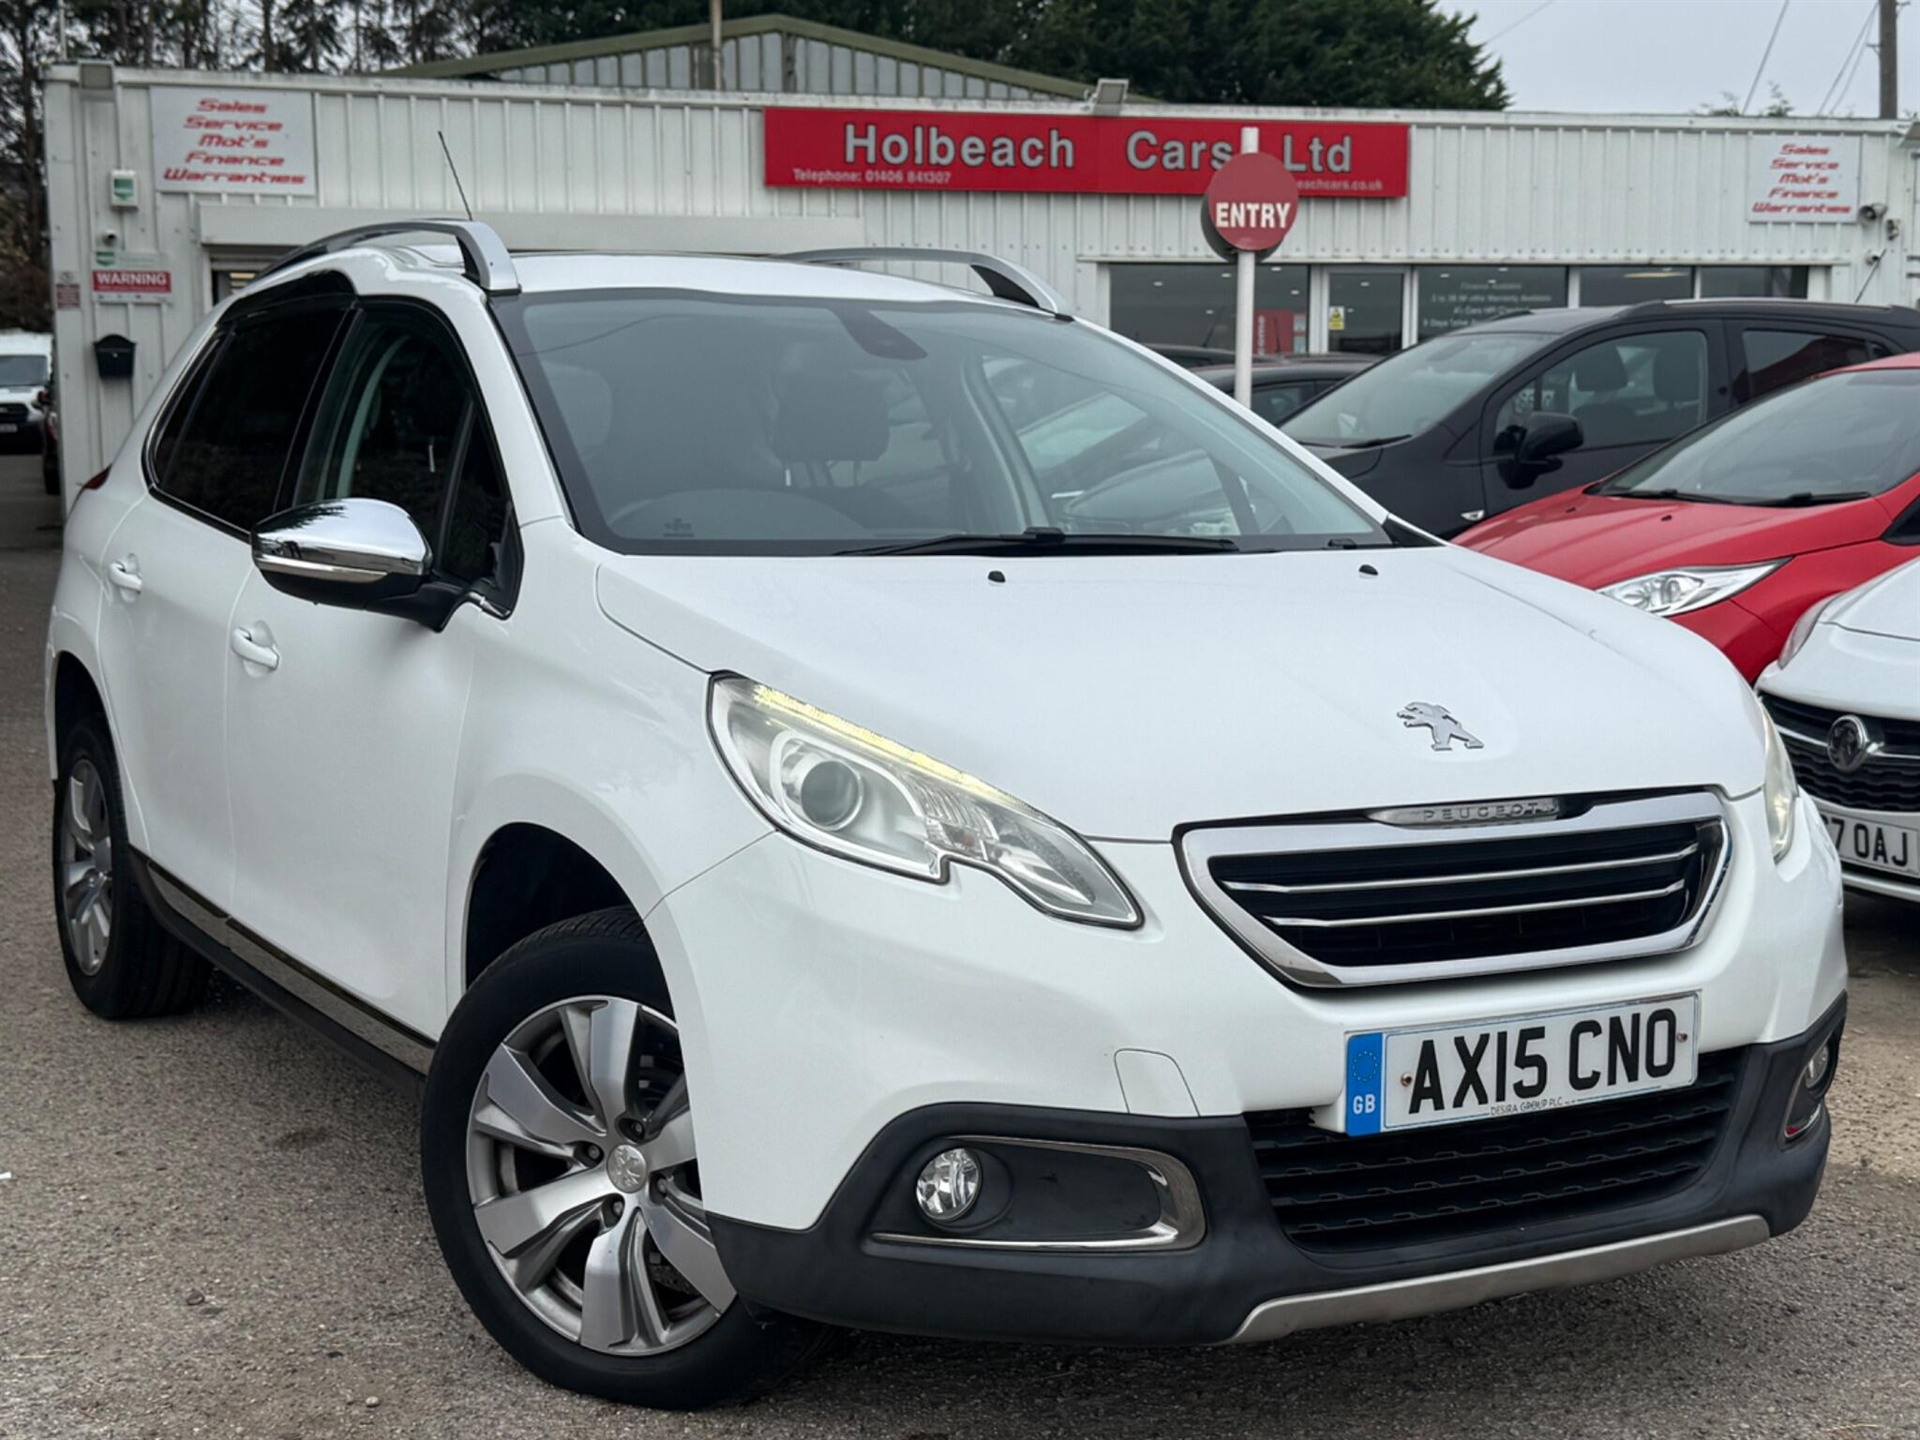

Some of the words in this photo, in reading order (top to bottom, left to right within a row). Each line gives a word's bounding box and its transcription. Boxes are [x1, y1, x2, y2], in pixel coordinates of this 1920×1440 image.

[197, 98, 268, 113] Sales
[184, 115, 283, 131] Service
[844, 123, 1075, 168] Holbeach
[1126, 130, 1234, 171] Cars
[1282, 133, 1353, 172] Ltd
[1780, 143, 1830, 155] Sales
[185, 150, 285, 166] Finance
[1770, 157, 1839, 170] Service
[163, 167, 305, 184] Warranties
[793, 168, 861, 183] Telephone:
[1768, 187, 1838, 198] Finance
[1215, 202, 1291, 228] ENTRY
[1752, 202, 1851, 214] Warranties
[97, 273, 167, 285] WARNING
[1423, 801, 1540, 822] PEUGEOT
[1854, 822, 1908, 867] OAJ
[1408, 1026, 1549, 1115] AX15
[1569, 1008, 1677, 1091] CNO
[1352, 1093, 1376, 1115] GB
